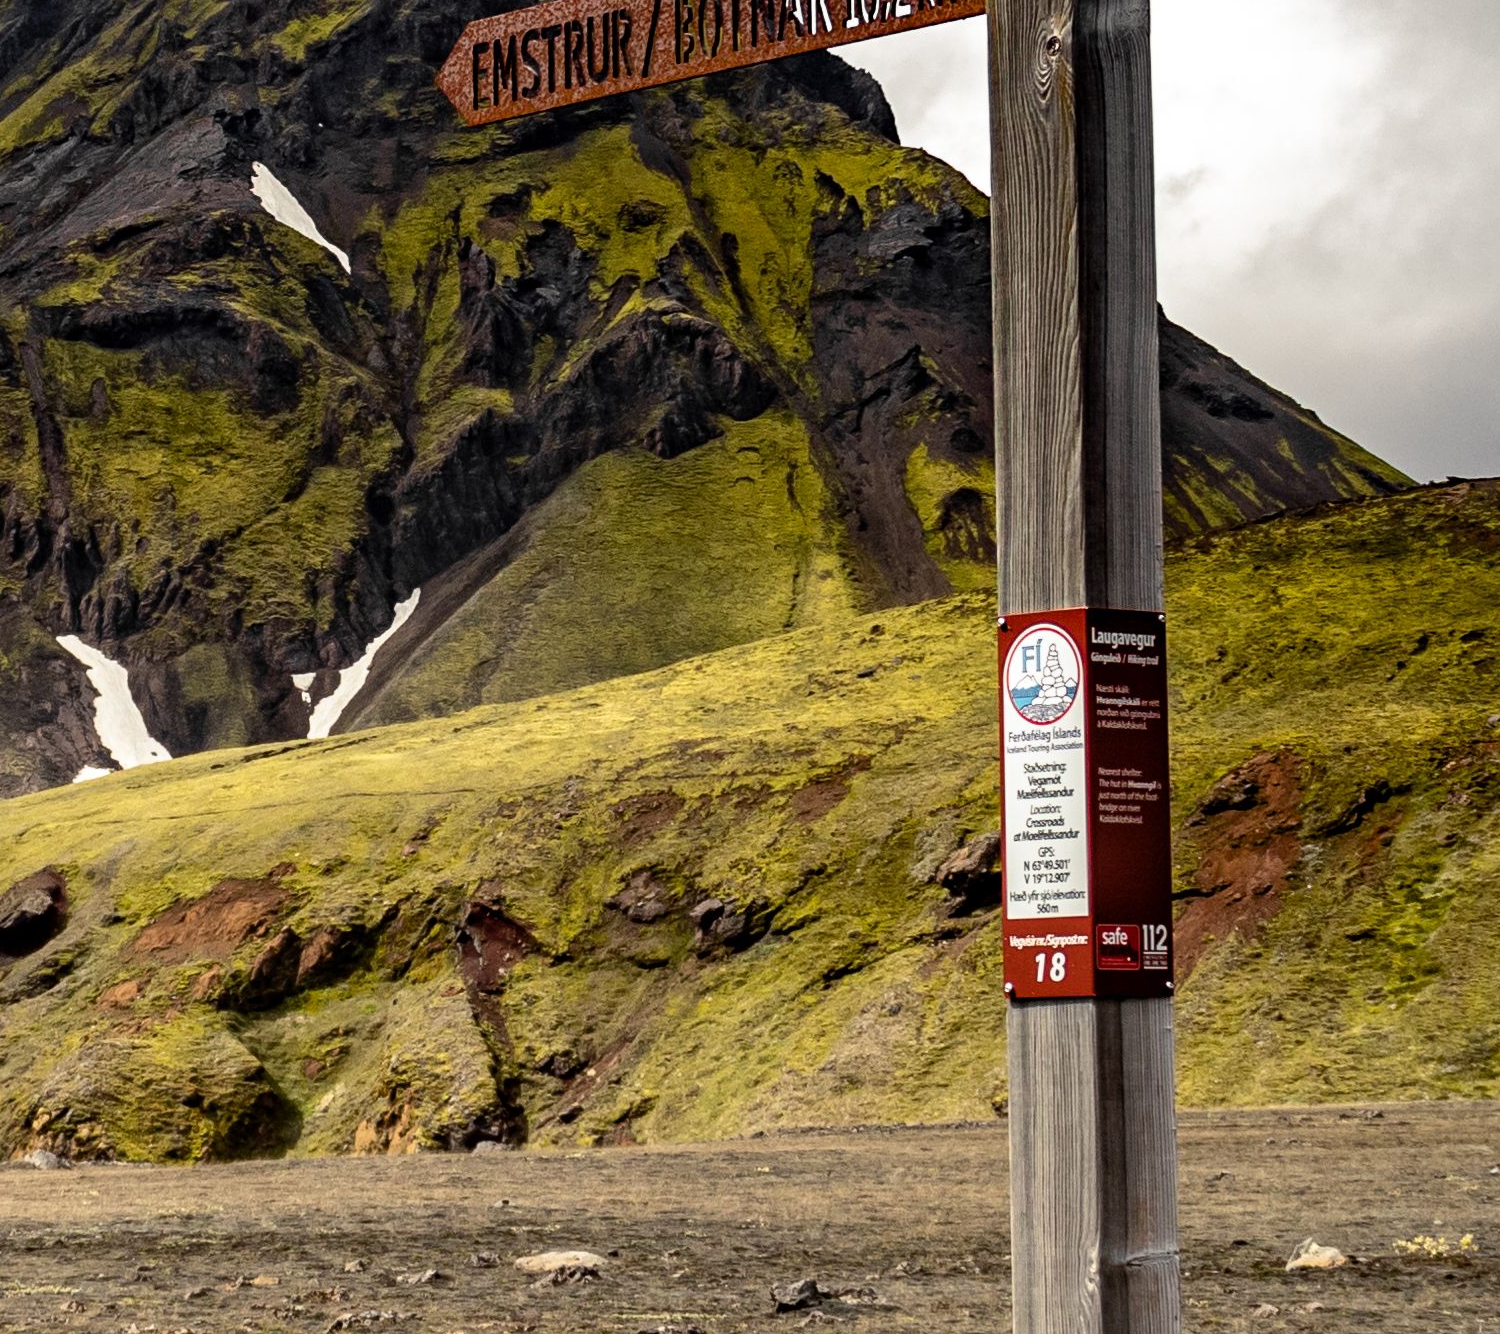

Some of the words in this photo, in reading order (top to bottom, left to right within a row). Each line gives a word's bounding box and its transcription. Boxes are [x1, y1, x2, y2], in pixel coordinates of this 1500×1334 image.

[472, 8, 632, 111] EMSTRUR
[1092, 627, 1156, 650] Laugavegur
[1022, 639, 1043, 673] FÍ
[1008, 729, 1051, 743] Ferðafélag
[1053, 726, 1082, 739] Íslands
[1028, 744, 1049, 753] Touring
[1051, 741, 1083, 750] Association
[1026, 816, 1064, 828] Crossroads
[1024, 861, 1030, 871] N
[1024, 874, 1030, 884] V
[1102, 927, 1128, 945] safe
[1143, 924, 1168, 951] 112
[1035, 952, 1066, 983] 18
